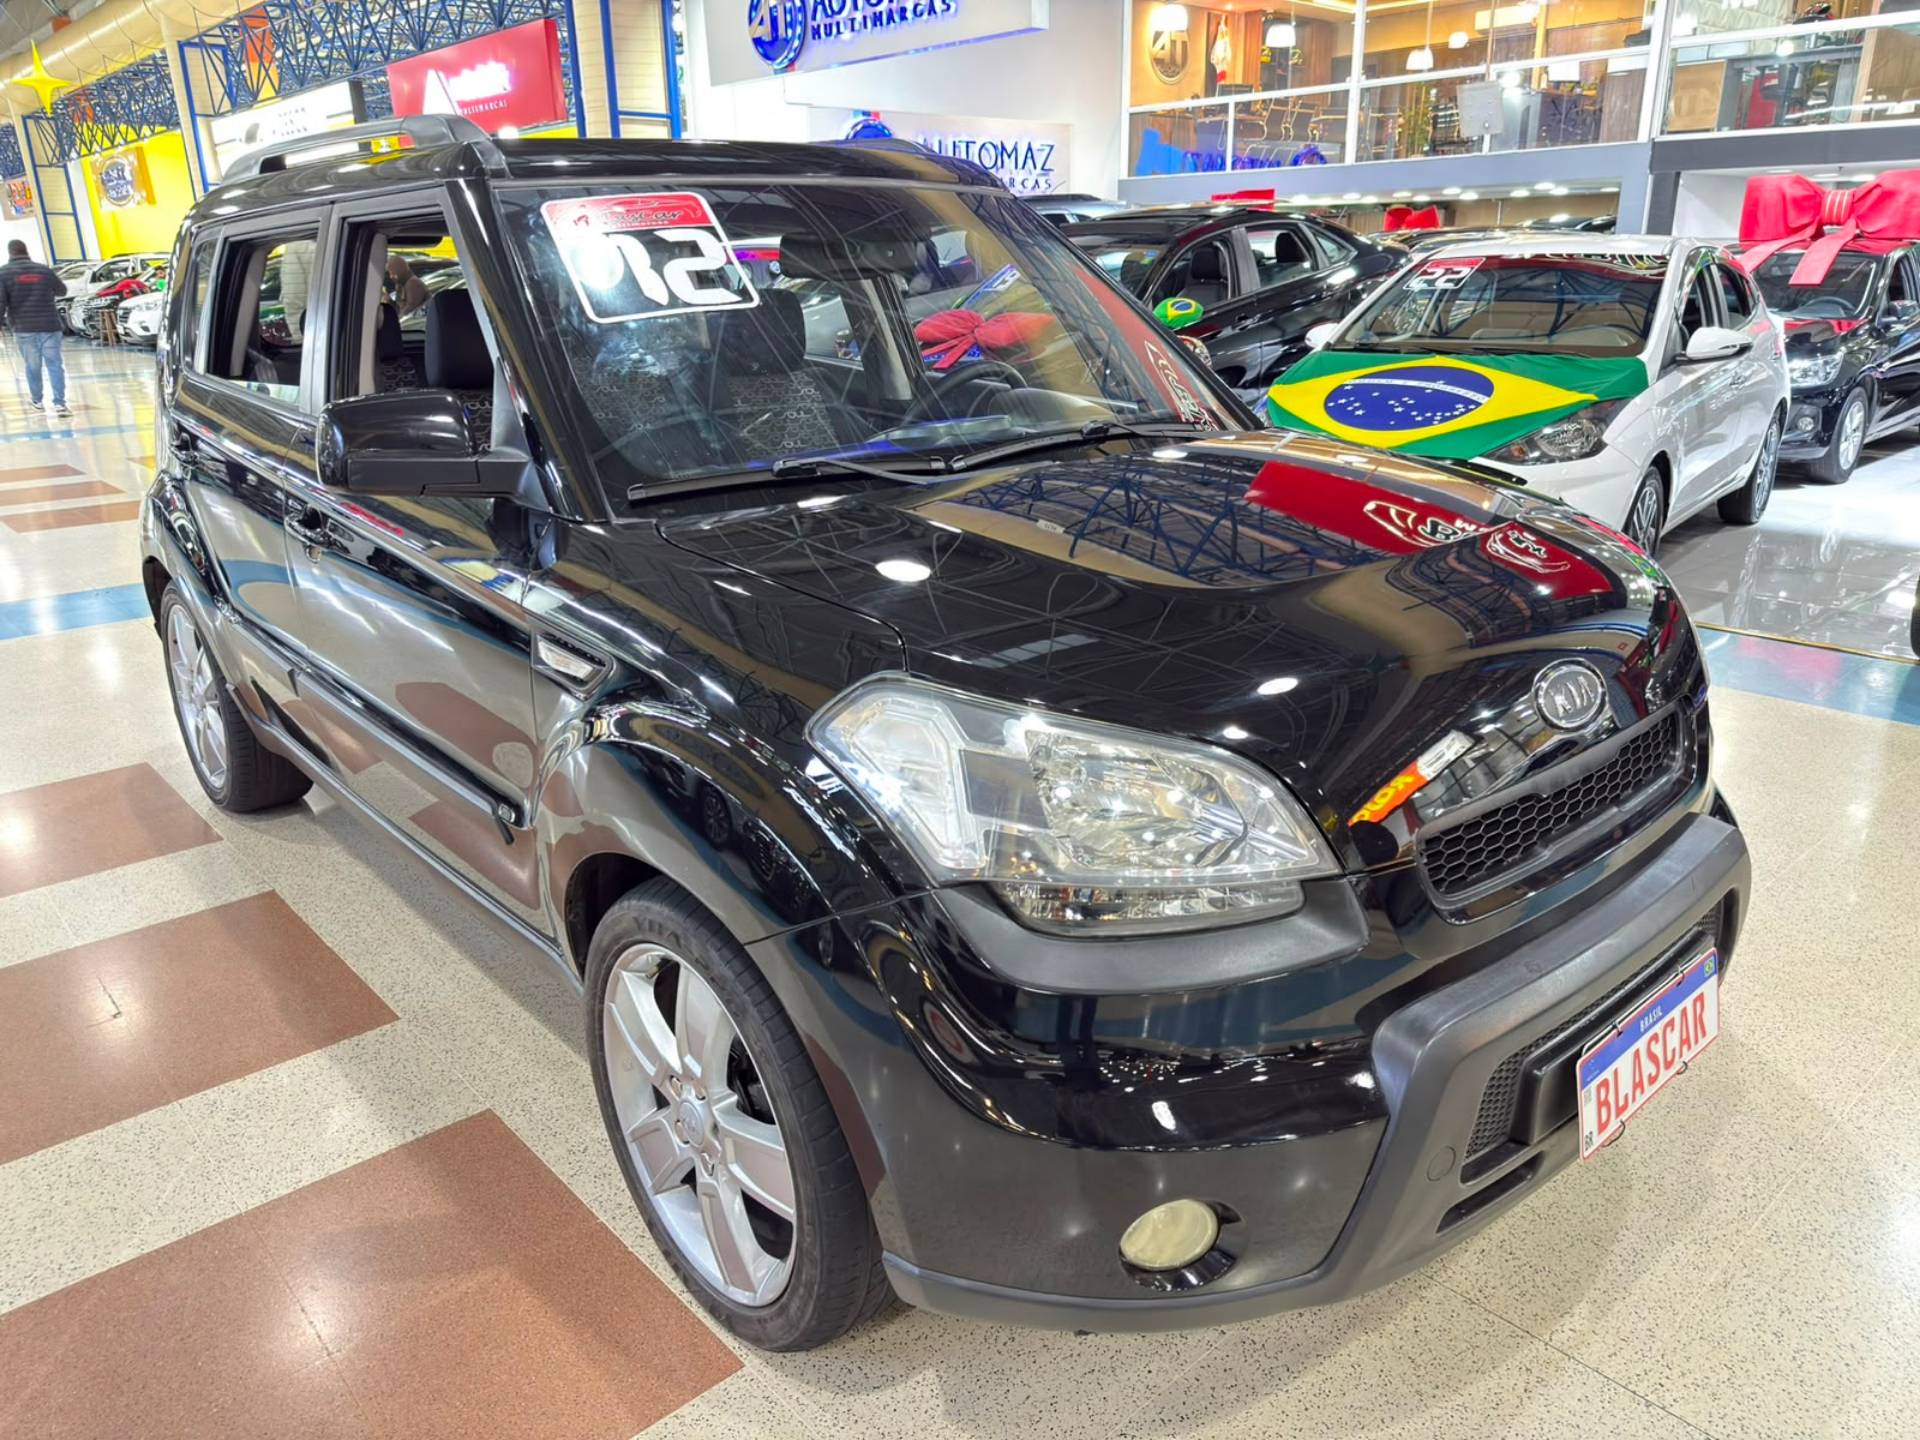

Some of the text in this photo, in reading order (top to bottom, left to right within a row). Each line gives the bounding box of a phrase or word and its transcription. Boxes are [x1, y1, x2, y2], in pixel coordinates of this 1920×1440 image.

[811, 0, 951, 40] MULTIMARCAS
[921, 137, 1055, 172] UTOMAZ
[1408, 267, 1472, 288] 22
[1639, 1005, 1663, 1032] BRASIL
[1595, 991, 1707, 1137] BLASCAR
